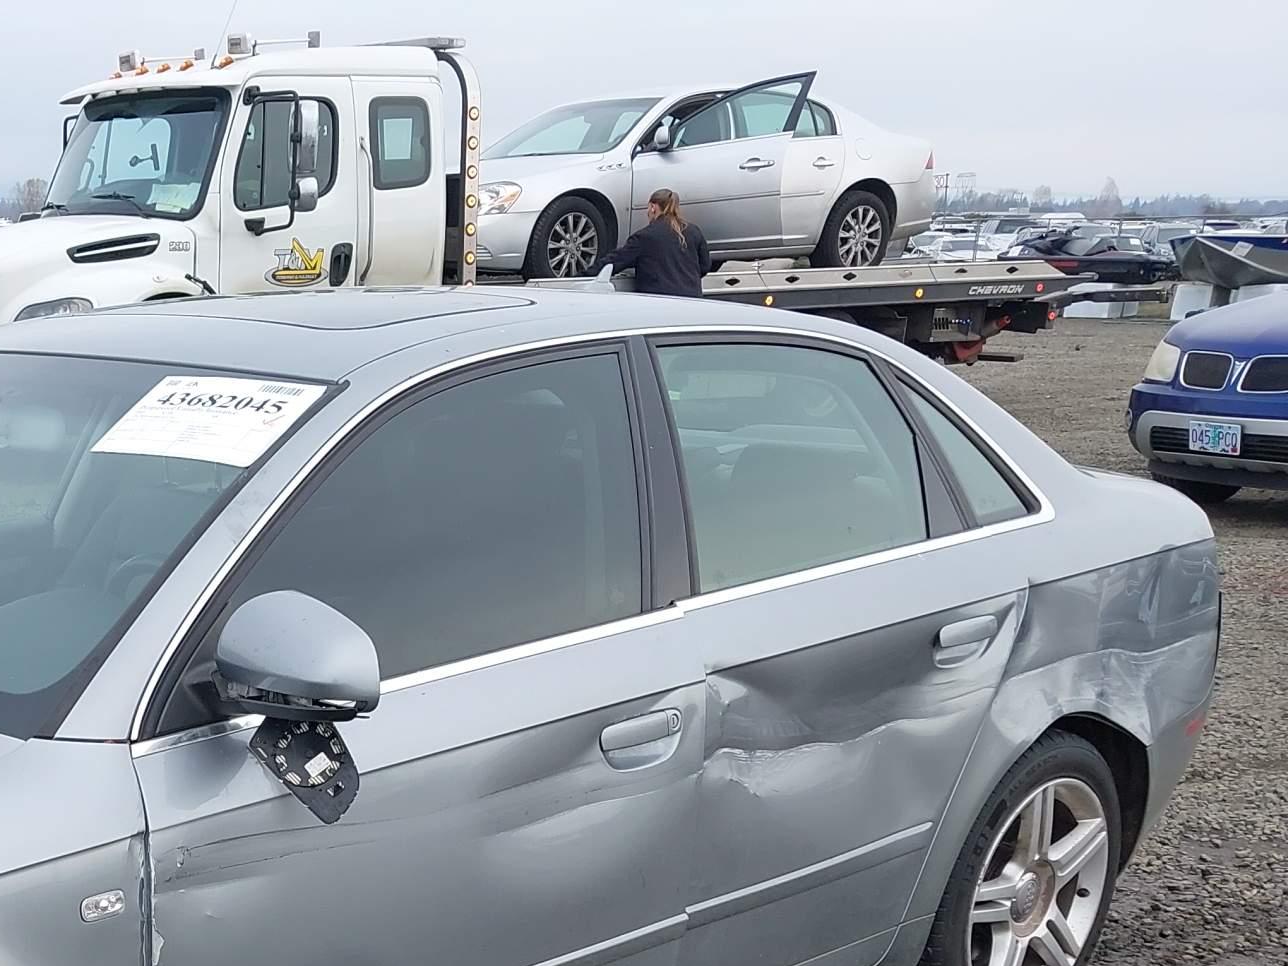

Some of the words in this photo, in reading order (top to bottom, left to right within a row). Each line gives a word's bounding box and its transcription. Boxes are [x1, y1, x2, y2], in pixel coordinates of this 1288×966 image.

[968, 284, 1025, 296] CHEVRON
[157, 391, 289, 415] 43682045
[1191, 428, 1211, 445] 045
